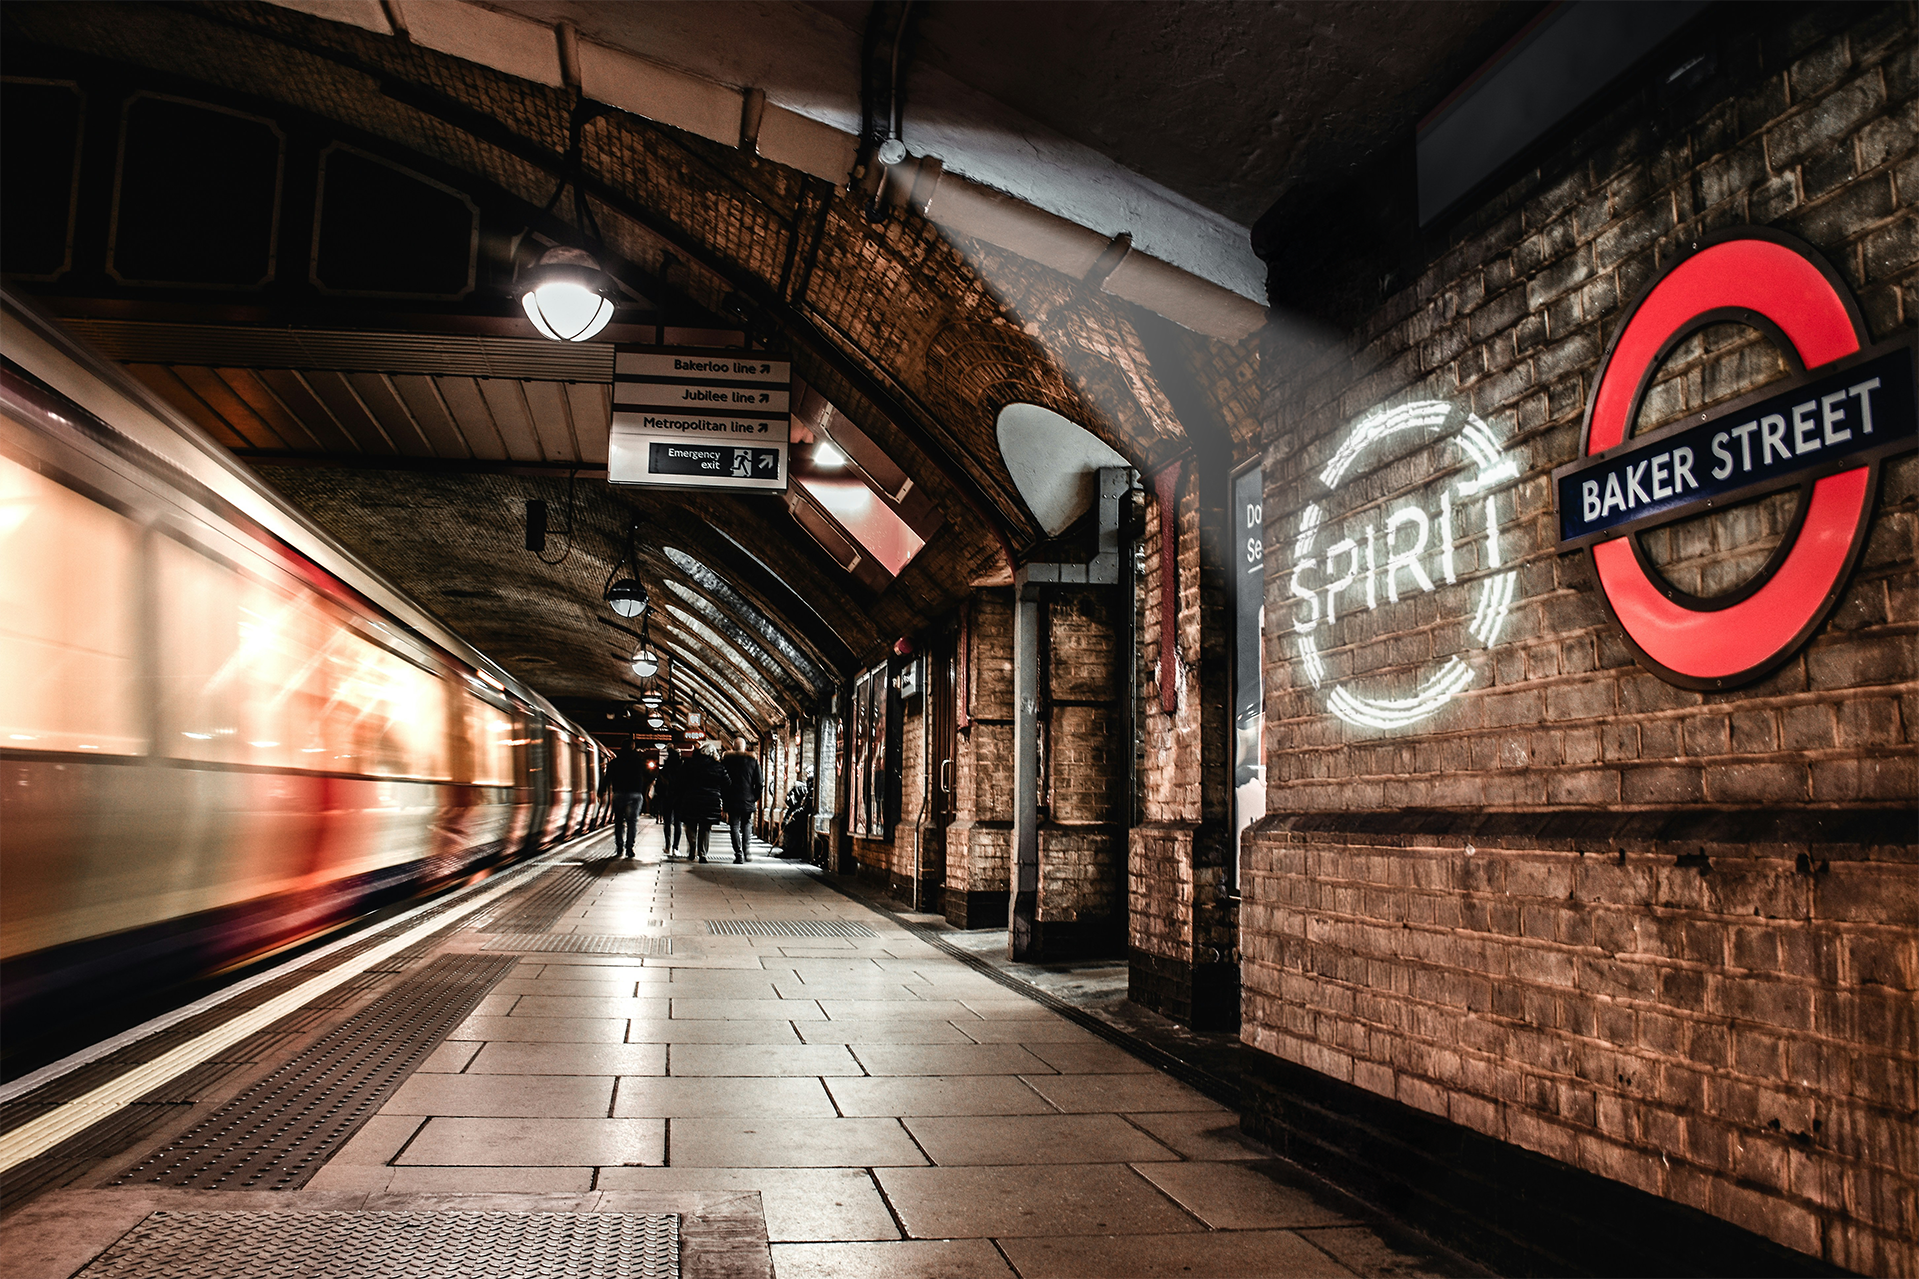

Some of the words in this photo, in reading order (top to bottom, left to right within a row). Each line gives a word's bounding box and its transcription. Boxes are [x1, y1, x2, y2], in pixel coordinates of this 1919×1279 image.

[674, 359, 729, 374] Bakerloo
[733, 362, 756, 375] line
[682, 389, 728, 402] Jubilee
[732, 392, 755, 404] line
[643, 417, 727, 432] Metropolitan
[731, 421, 754, 433] line
[668, 448, 721, 461] Emergency
[1582, 446, 1699, 523] BAKER
[1711, 377, 1881, 481] STREET
[701, 461, 721, 470] exit
[1291, 461, 1520, 634] SPIRIT
